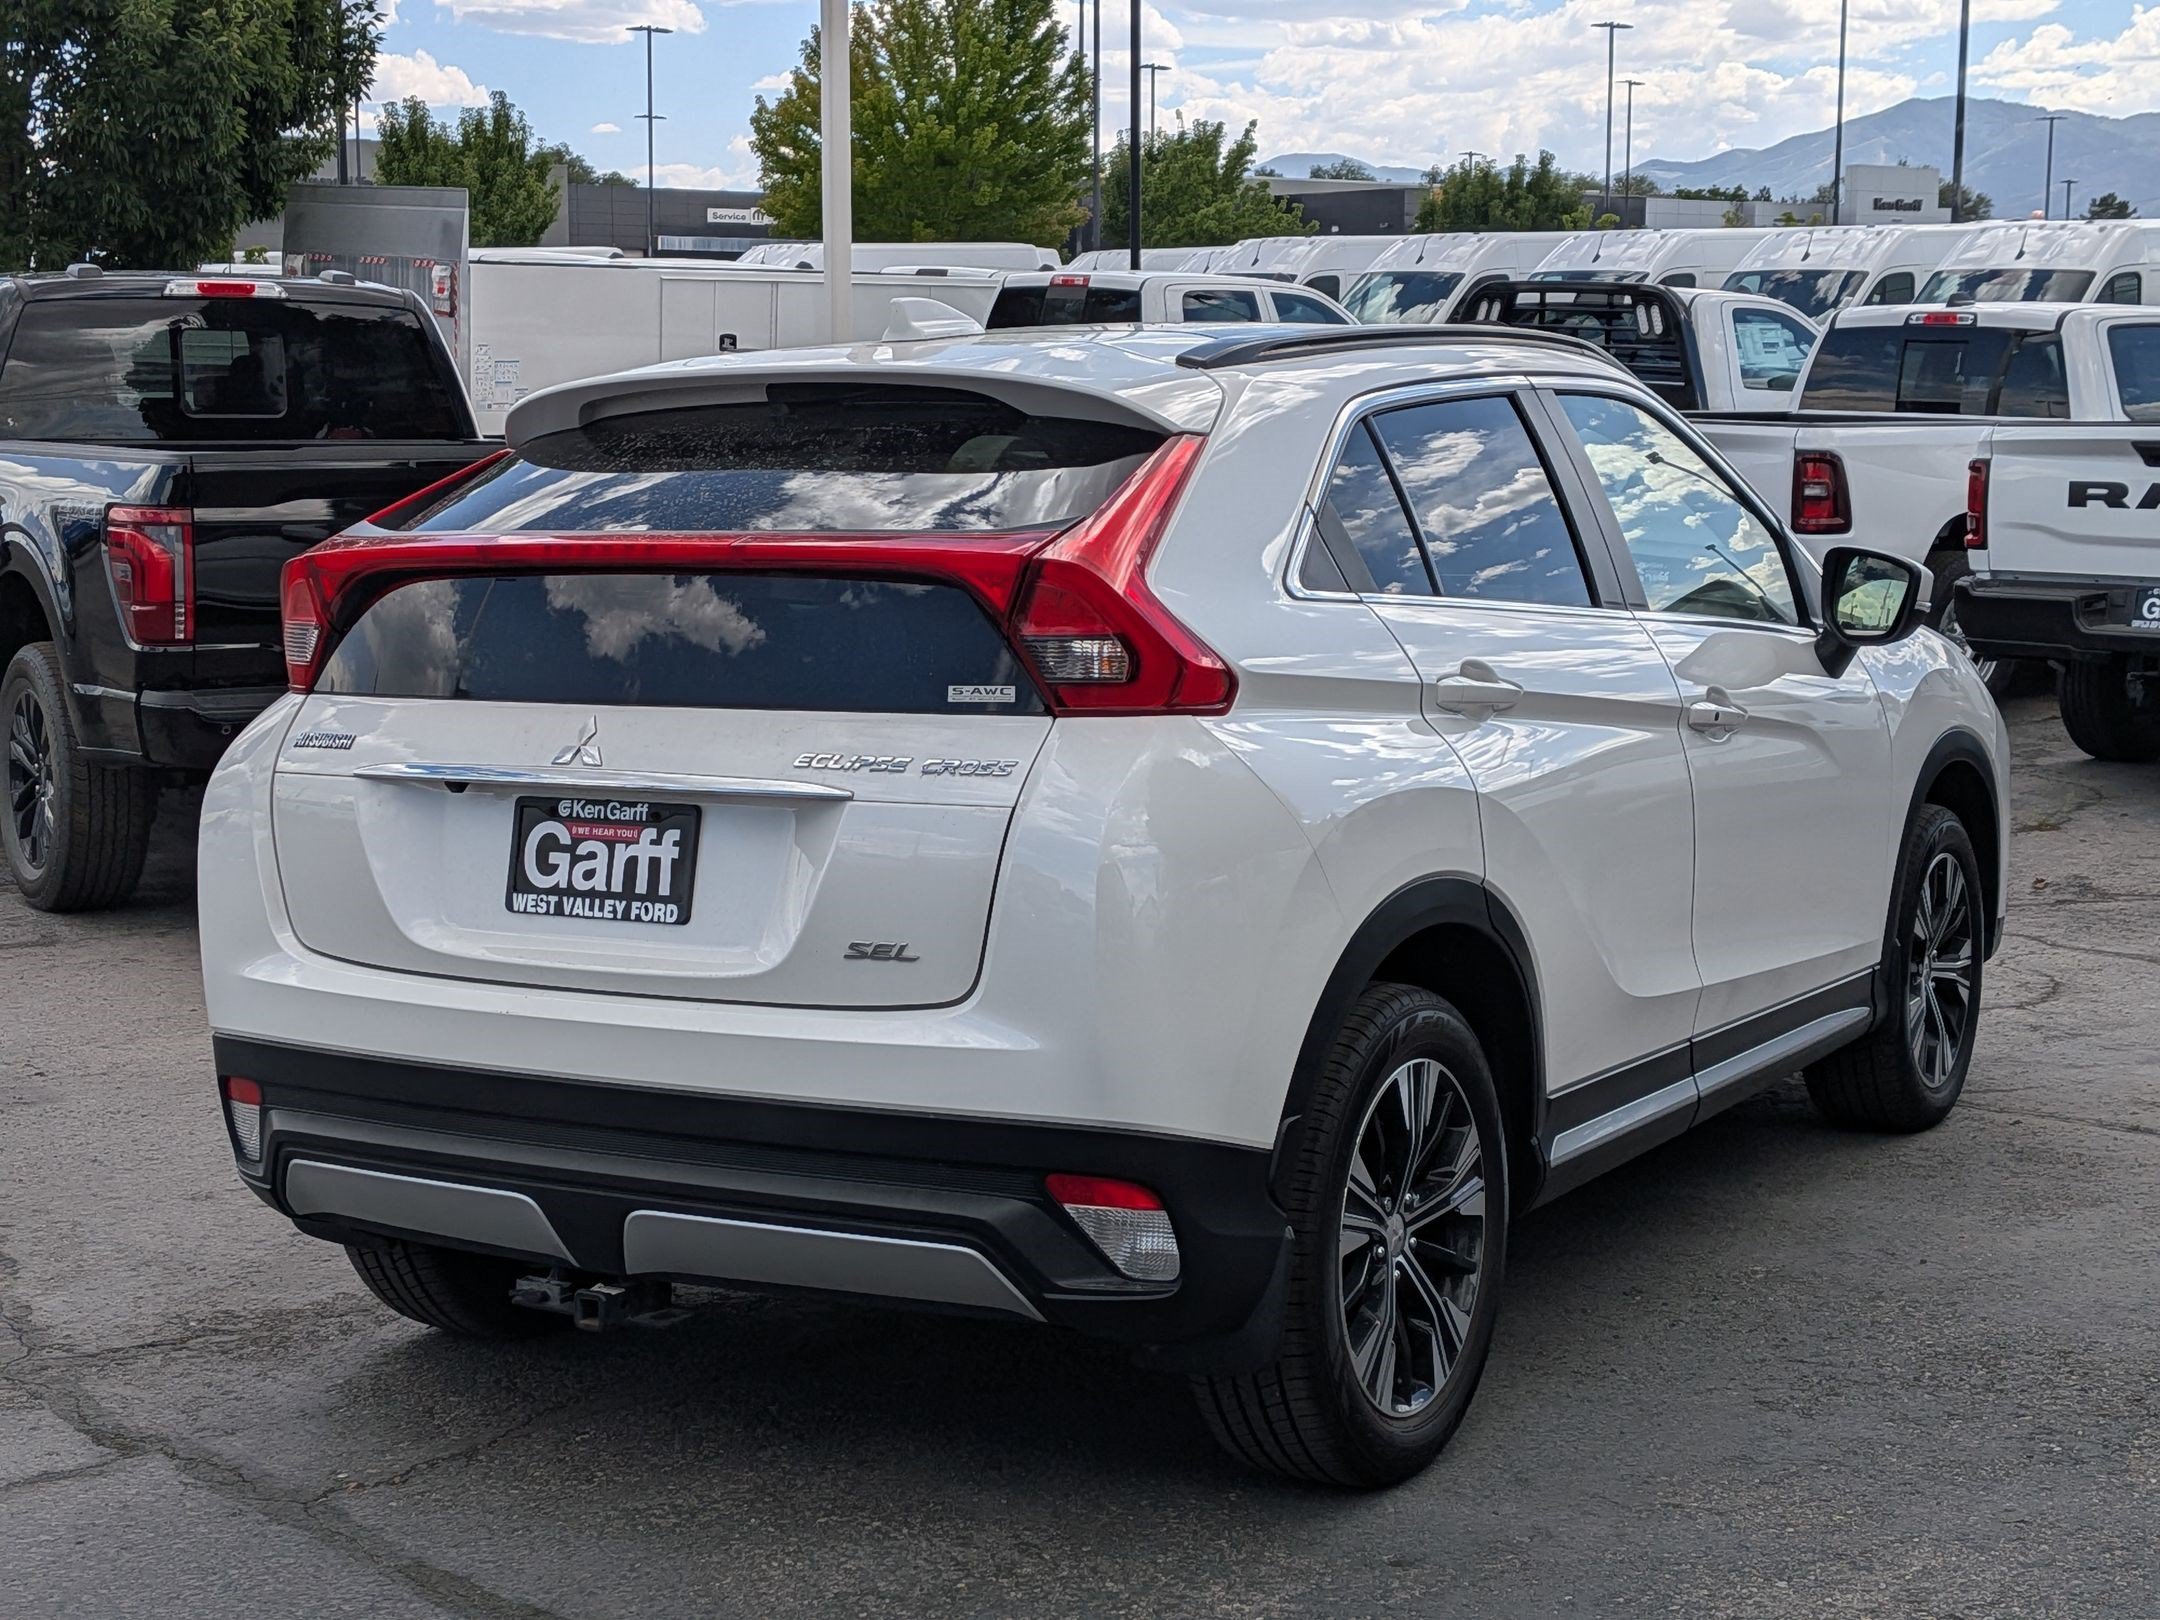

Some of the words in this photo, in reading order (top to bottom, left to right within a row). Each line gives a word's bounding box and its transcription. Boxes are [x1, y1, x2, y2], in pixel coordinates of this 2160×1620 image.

[712, 211, 746, 220] Service
[952, 687, 1012, 695] S-AWC
[792, 752, 913, 773] ECLIPSE
[920, 758, 1020, 777] CROSS
[572, 800, 605, 819] Ken
[607, 802, 649, 821] Garff
[577, 826, 590, 835] WE
[592, 827, 615, 837] HEAR
[616, 829, 633, 838] YOU
[524, 820, 681, 896] Garff
[513, 893, 559, 914] WEST
[562, 896, 627, 918] VALLEY
[630, 901, 679, 923] FORD
[843, 940, 920, 962] SEL
